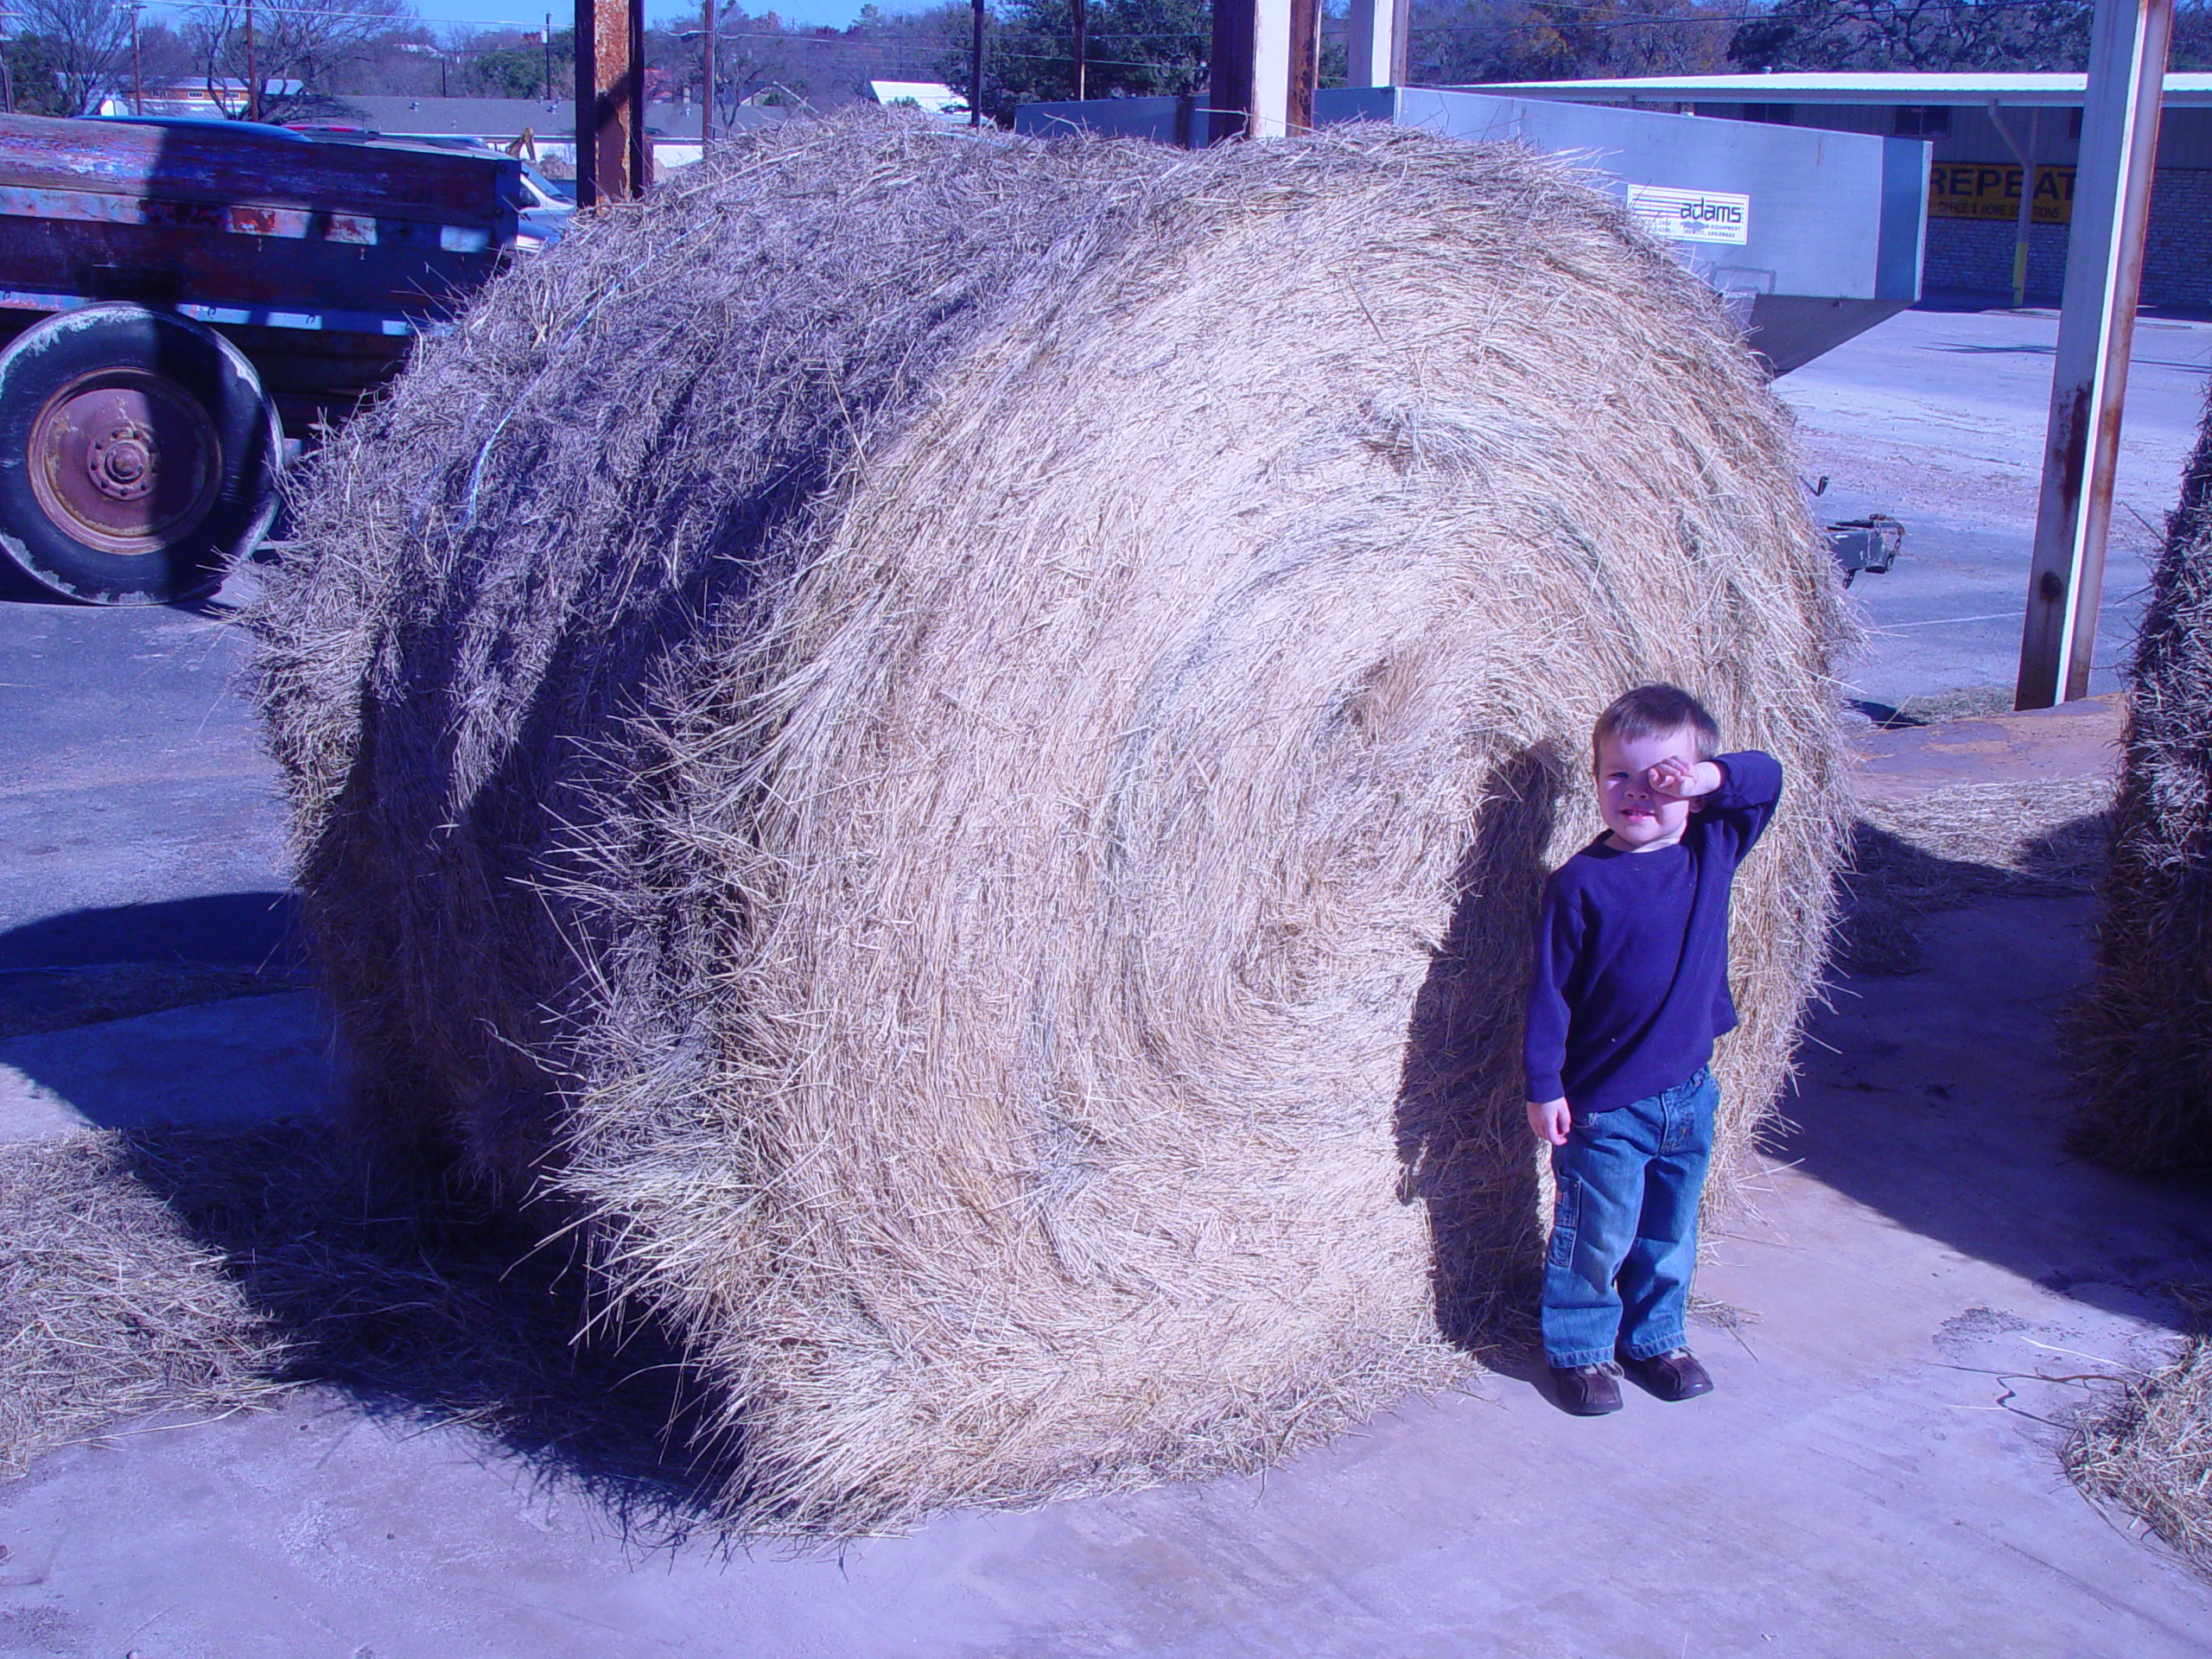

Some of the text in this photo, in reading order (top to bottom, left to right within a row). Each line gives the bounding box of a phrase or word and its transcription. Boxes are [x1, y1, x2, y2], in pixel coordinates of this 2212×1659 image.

[1930, 167, 2076, 201] REPEAT
[1680, 196, 1741, 223] adams
[1938, 200, 2060, 219] OFFICE & HOME SOTIONS
